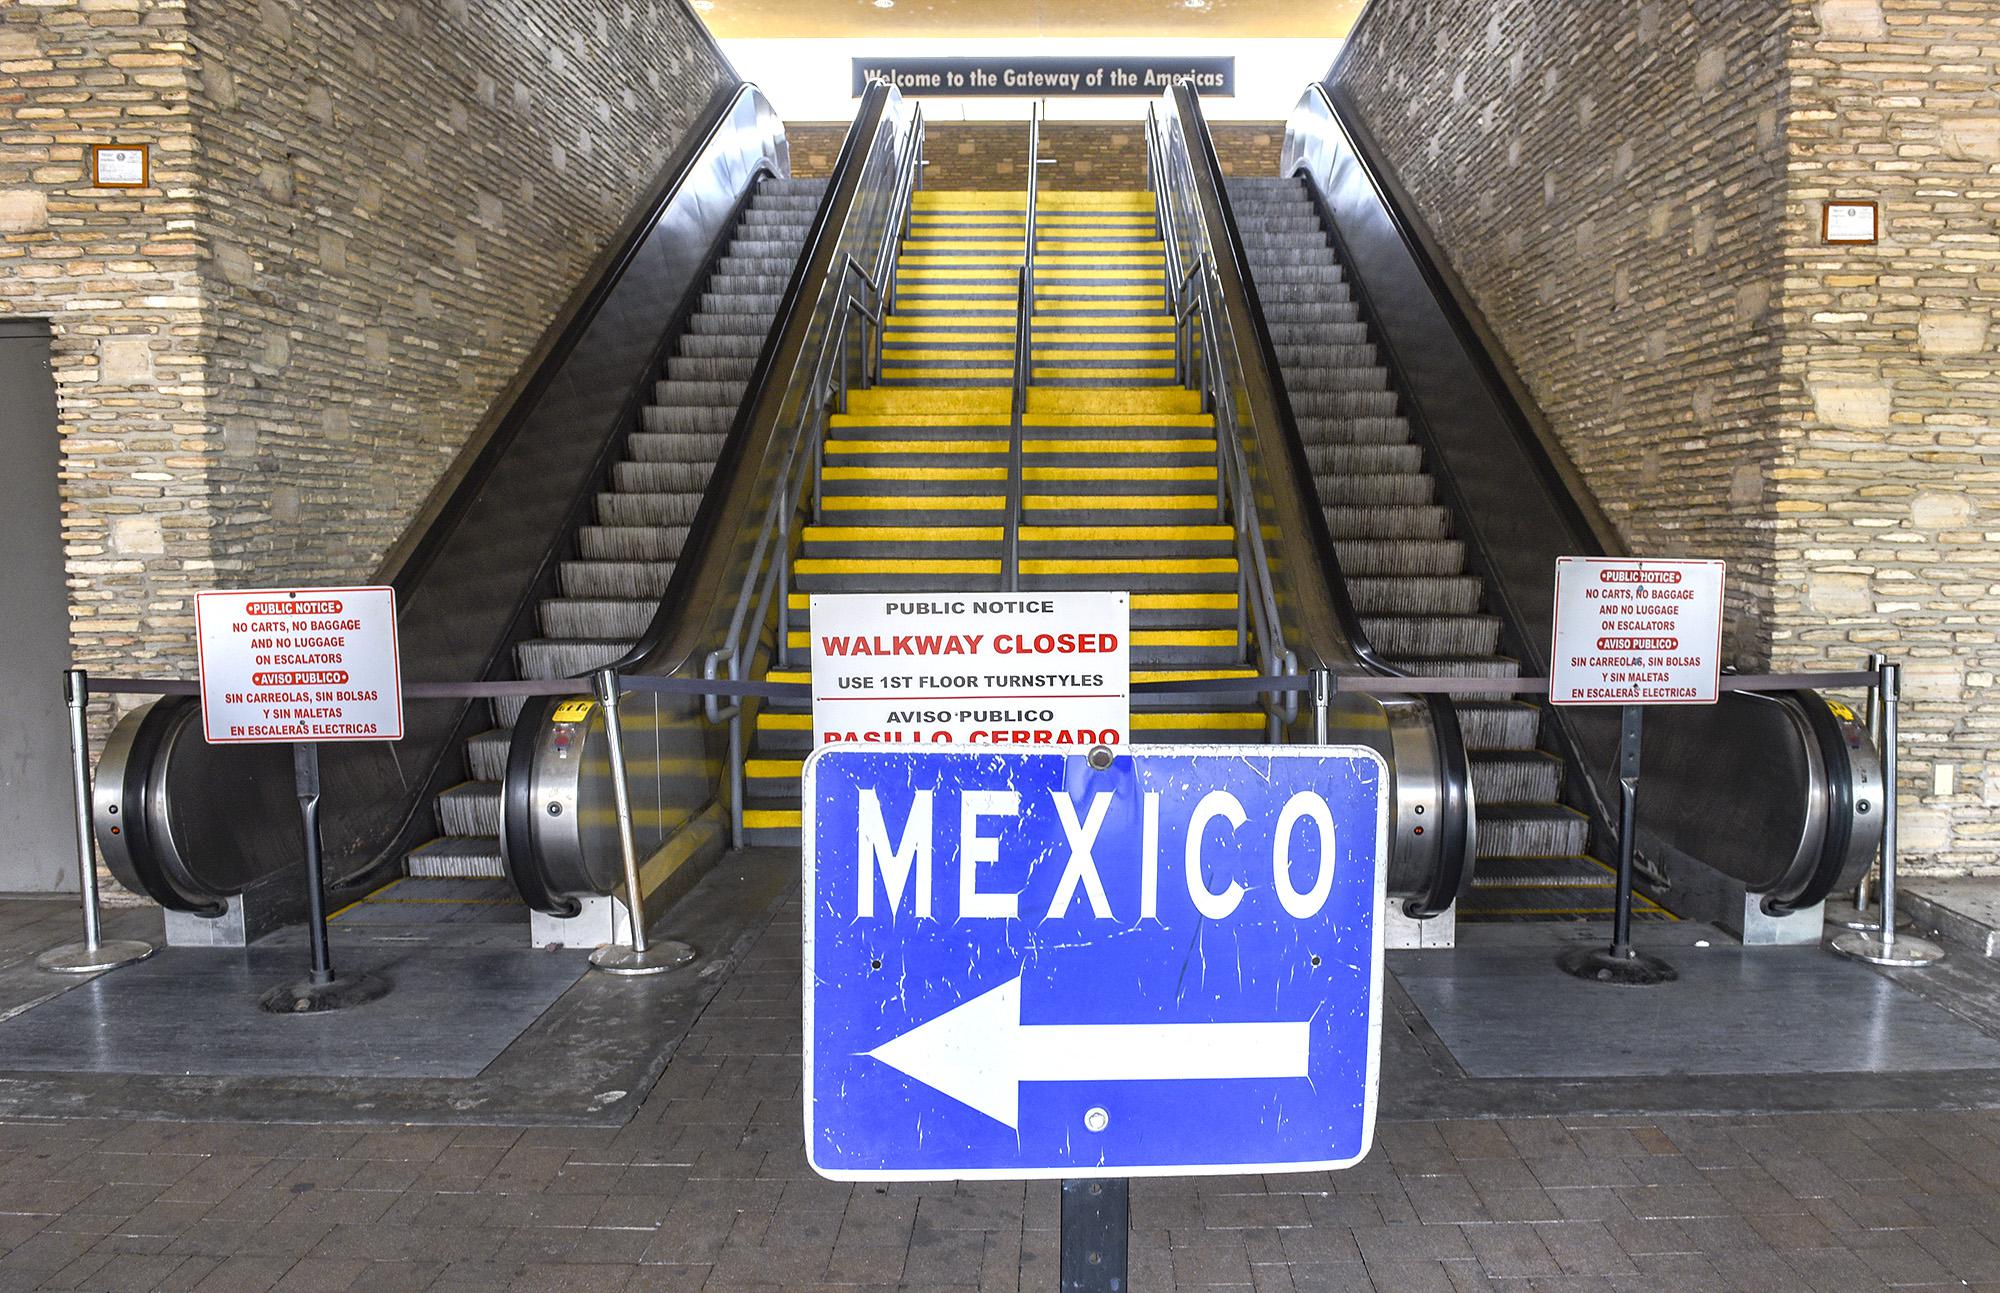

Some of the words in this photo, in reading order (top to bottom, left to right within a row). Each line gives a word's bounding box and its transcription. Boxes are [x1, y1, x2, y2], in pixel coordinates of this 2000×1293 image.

[946, 71, 964, 86] to
[970, 68, 997, 86] the
[1004, 69, 1080, 90] Gateway
[1086, 68, 1104, 86] of
[1110, 68, 1138, 86] the
[1606, 571, 1639, 582] PUBLIC
[1640, 572, 1675, 582] NOTICE
[1586, 589, 1598, 599] NO
[1602, 590, 1633, 600] CARTS,
[1636, 590, 1648, 599] NO
[1652, 590, 1694, 600] BAGGAGE
[253, 603, 293, 615] PUBLIC
[296, 601, 335, 614] NOTICE
[886, 602, 965, 615] PUBLIC
[973, 601, 1054, 614] NOTICE
[1600, 605, 1618, 615] AND
[1621, 605, 1633, 615] NO
[1636, 605, 1679, 615] LUGGAGE
[233, 622, 247, 632] NO
[251, 621, 289, 633] CARTS,
[292, 621, 307, 631] NO
[311, 620, 361, 630] BAGGAGE
[1602, 621, 1614, 630] ON
[1618, 621, 1675, 630] ESCALATORS
[251, 638, 272, 649] AND
[276, 638, 291, 648] NO
[294, 637, 345, 647] LUGGAGE
[822, 635, 984, 656] WALKWAY
[993, 634, 1118, 654] CLOSED
[1604, 639, 1631, 649] AVISO
[1633, 639, 1672, 649] PUBLICO
[256, 655, 271, 665] ON
[274, 653, 342, 664] ESCALATORS
[1571, 657, 1586, 667] SIN
[1590, 657, 1645, 668] CARREOLAS,
[1648, 657, 1663, 666] SIN
[1666, 657, 1701, 666] BOLSAS
[261, 673, 292, 684] AVISO
[295, 672, 341, 684] PUBLICO
[838, 677, 874, 689] USE
[880, 676, 913, 689] 1ST
[919, 675, 978, 688] FLOOR
[984, 674, 1104, 688] TURNSTYLES
[1602, 673, 1609, 682] Y
[1610, 673, 1625, 682] SIN
[1628, 672, 1669, 682] MALETAS
[225, 694, 242, 704] SIN
[246, 692, 312, 704] CARREOLAS,
[316, 692, 332, 702] SIN
[336, 691, 378, 701] BOLSAS
[1572, 689, 1584, 698] EN
[1587, 688, 1640, 698] ESCALERAS
[1642, 688, 1697, 697] ELECTRICAS
[263, 709, 270, 718] Y
[273, 708, 290, 719] SIN
[294, 708, 342, 718] MALETAS
[887, 711, 952, 723] AVISO
[960, 710, 1054, 722] PUBLICO
[231, 726, 244, 736] EN
[248, 725, 309, 735] ESCALERAS
[312, 724, 377, 734] ELECTRICAS
[856, 789, 1336, 920] MEXICO
